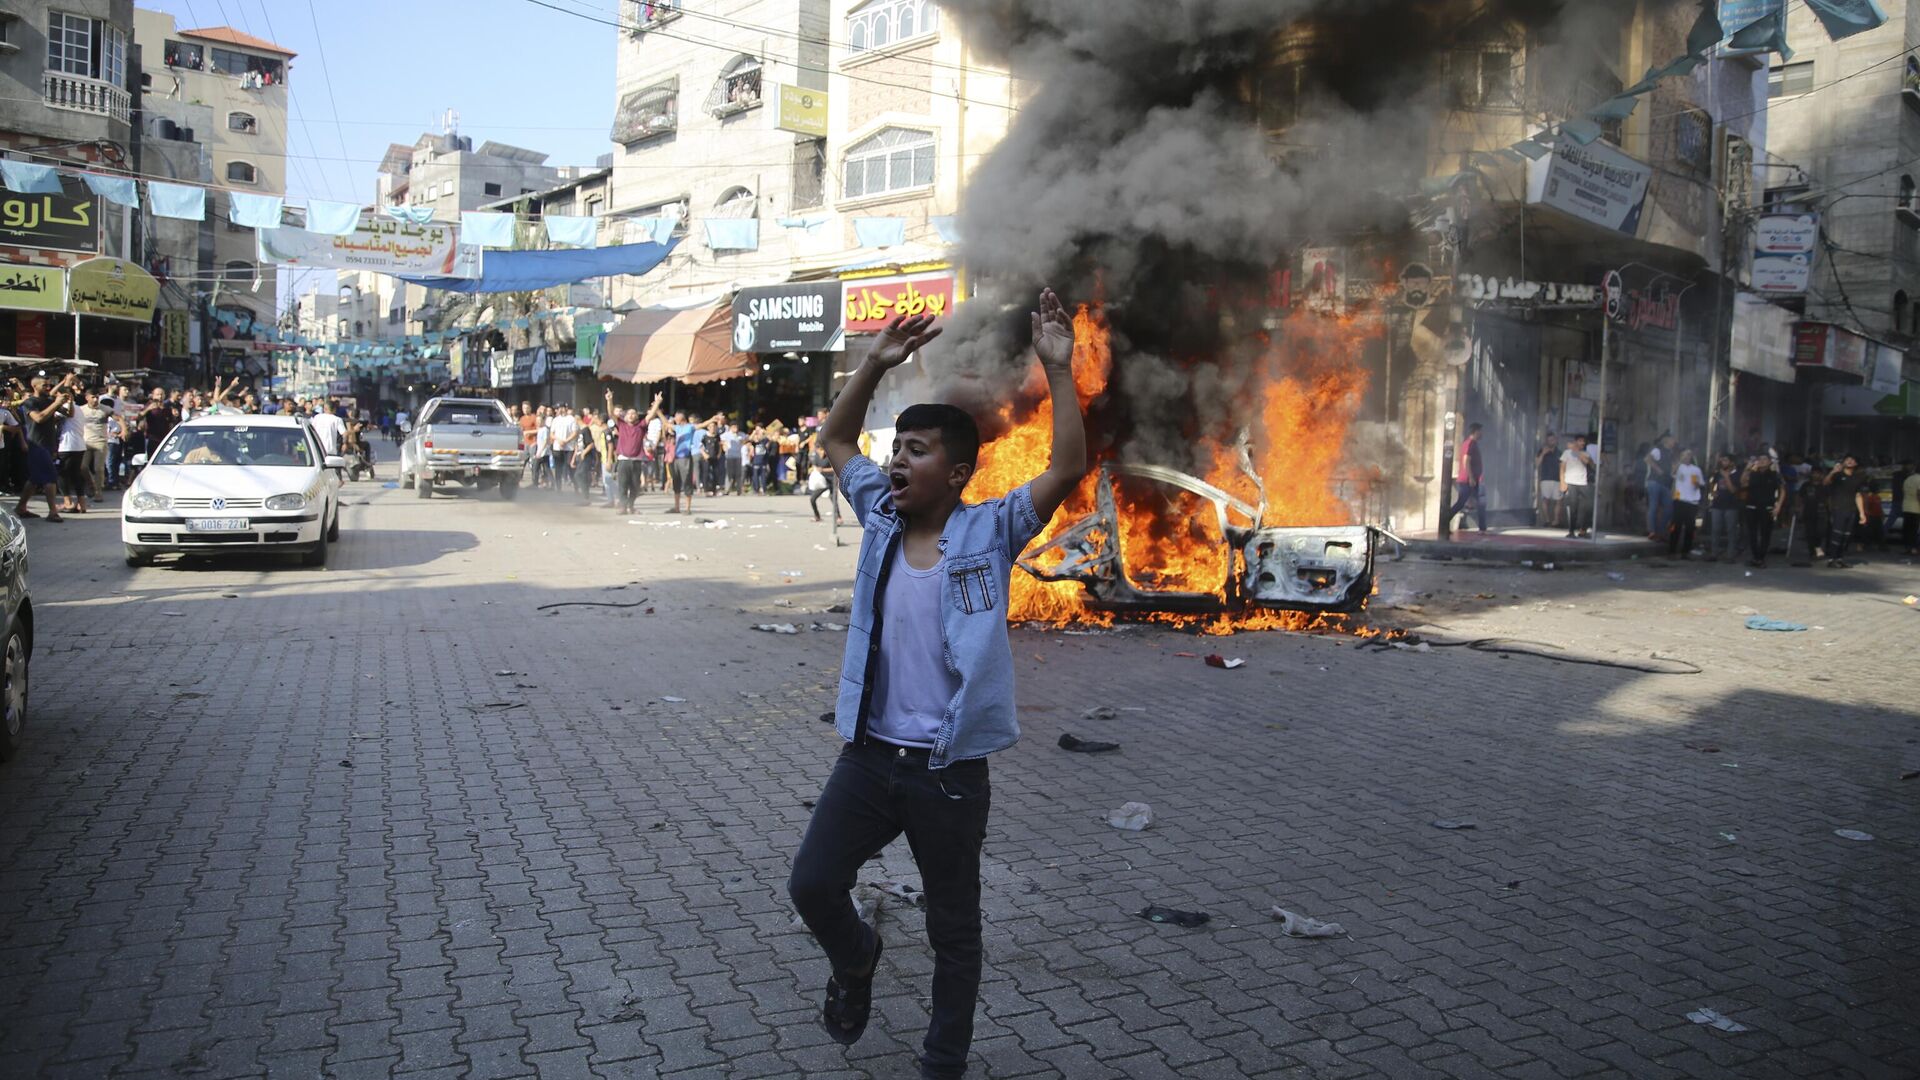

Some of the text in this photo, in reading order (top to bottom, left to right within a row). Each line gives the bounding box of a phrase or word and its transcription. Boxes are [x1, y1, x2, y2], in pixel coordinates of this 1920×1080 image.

[355, 219, 444, 244] يوجد لدين
[0, 272, 46, 294] المطع
[749, 294, 824, 321] SAMSUNG
[895, 281, 945, 317] بوظة
[798, 320, 825, 333] Mobile
